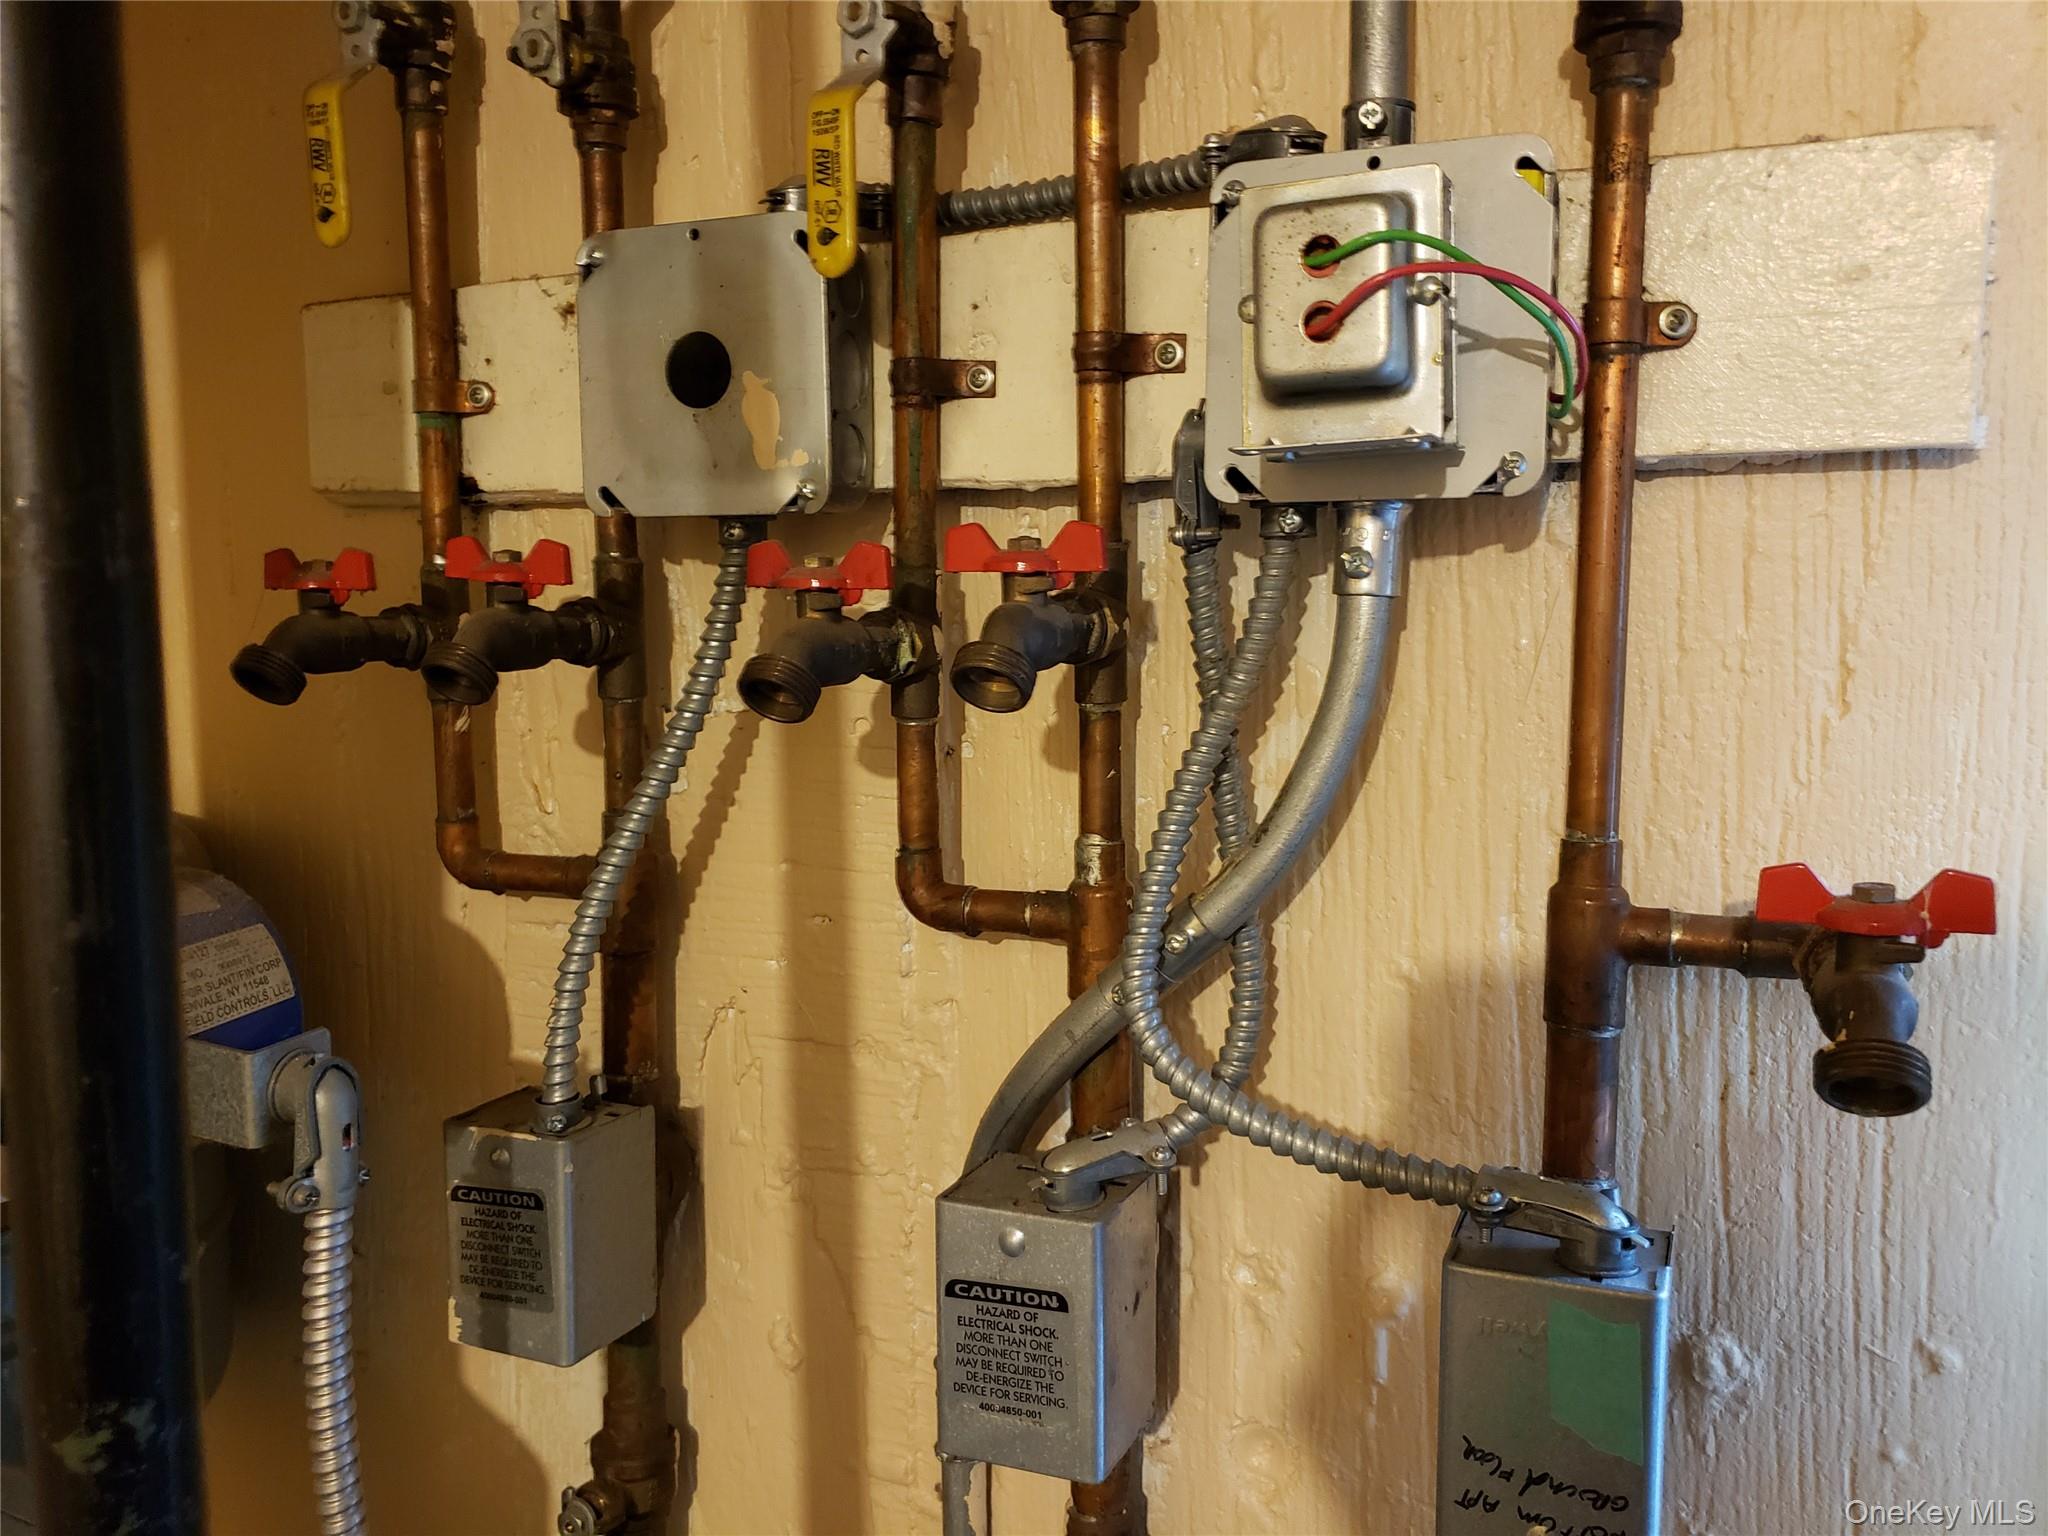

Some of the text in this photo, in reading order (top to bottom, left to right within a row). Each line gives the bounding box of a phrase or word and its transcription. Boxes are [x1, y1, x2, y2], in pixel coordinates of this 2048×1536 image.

[311, 138, 325, 171] RWV
[815, 149, 833, 187] RWV
[257, 958, 281, 973] CORP
[226, 985, 241, 997] NY
[243, 975, 270, 990] 11548
[272, 983, 290, 998] LLC
[457, 1189, 535, 1207] CAUTION
[474, 1207, 522, 1220] HAZARD OF
[461, 1217, 505, 1231] ELECTRICAL
[466, 1231, 534, 1246] MORE THAN ONE
[461, 1240, 541, 1258] DISCONNECT SWITCH
[461, 1253, 543, 1271] MAY BE REQUIRED TO
[460, 1275, 485, 1287] DEVICE
[488, 1279, 503, 1289] FOR
[521, 1271, 537, 1281] THE
[954, 1283, 1060, 1308] CAUTION
[976, 1304, 1039, 1323] HAZARD OF
[957, 1316, 1059, 1340] ELECTRICAL SHOCK.
[963, 1331, 1053, 1353] MORE THAN ONE
[956, 1342, 1063, 1368] DISCONNECT SWITCH
[955, 1356, 1064, 1381] MAY BE REQUIRED TO
[966, 1371, 1055, 1394] DE-ENERGIZE THE
[953, 1382, 1069, 1409] DEVICE FOR SERVICING.
[1454, 1489, 1500, 1513] APT
